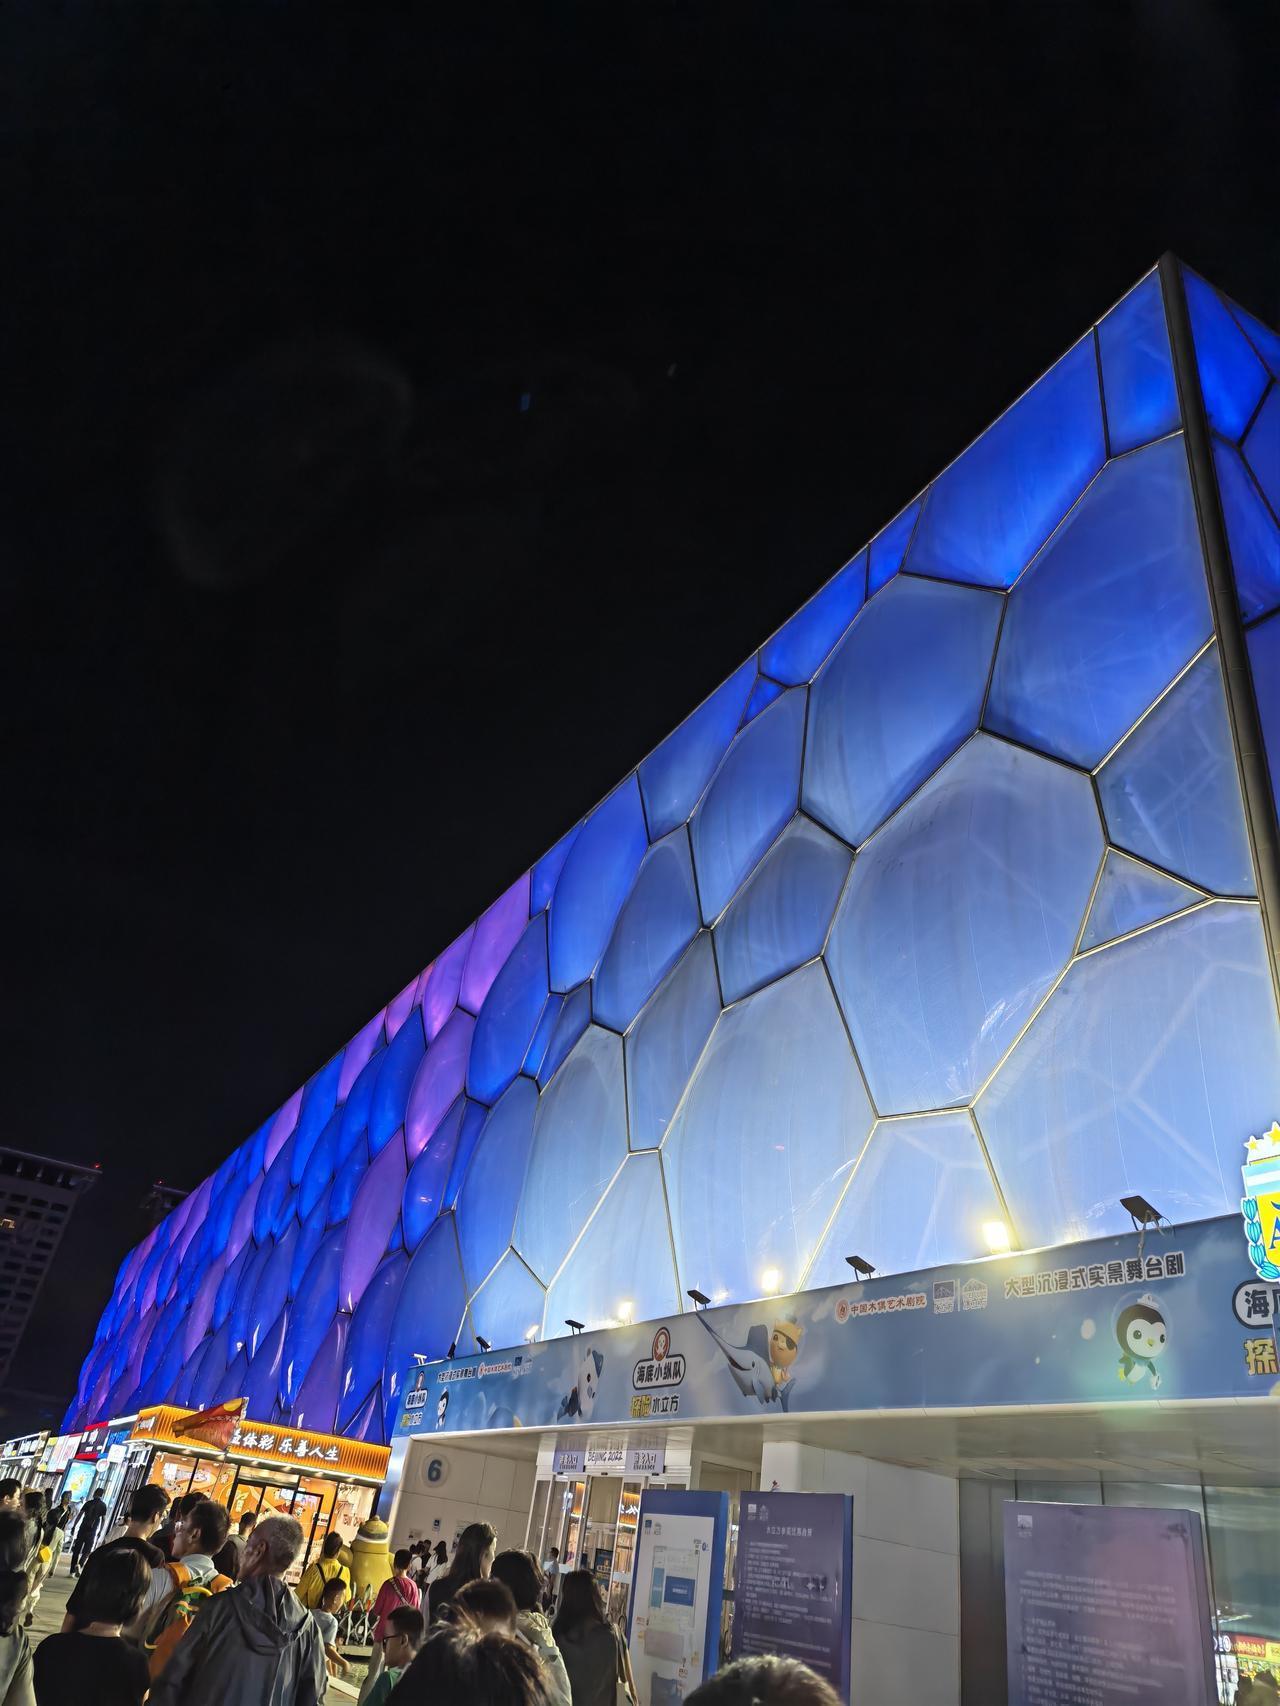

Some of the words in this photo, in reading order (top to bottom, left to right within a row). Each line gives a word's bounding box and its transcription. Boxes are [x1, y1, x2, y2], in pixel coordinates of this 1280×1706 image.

[1005, 1252, 1185, 1298] 大型沉浸式实景舞台剧
[636, 1360, 682, 1384] 海底小纵队
[279, 1438, 339, 1461] 乐善人生
[427, 1459, 443, 1482] 6
